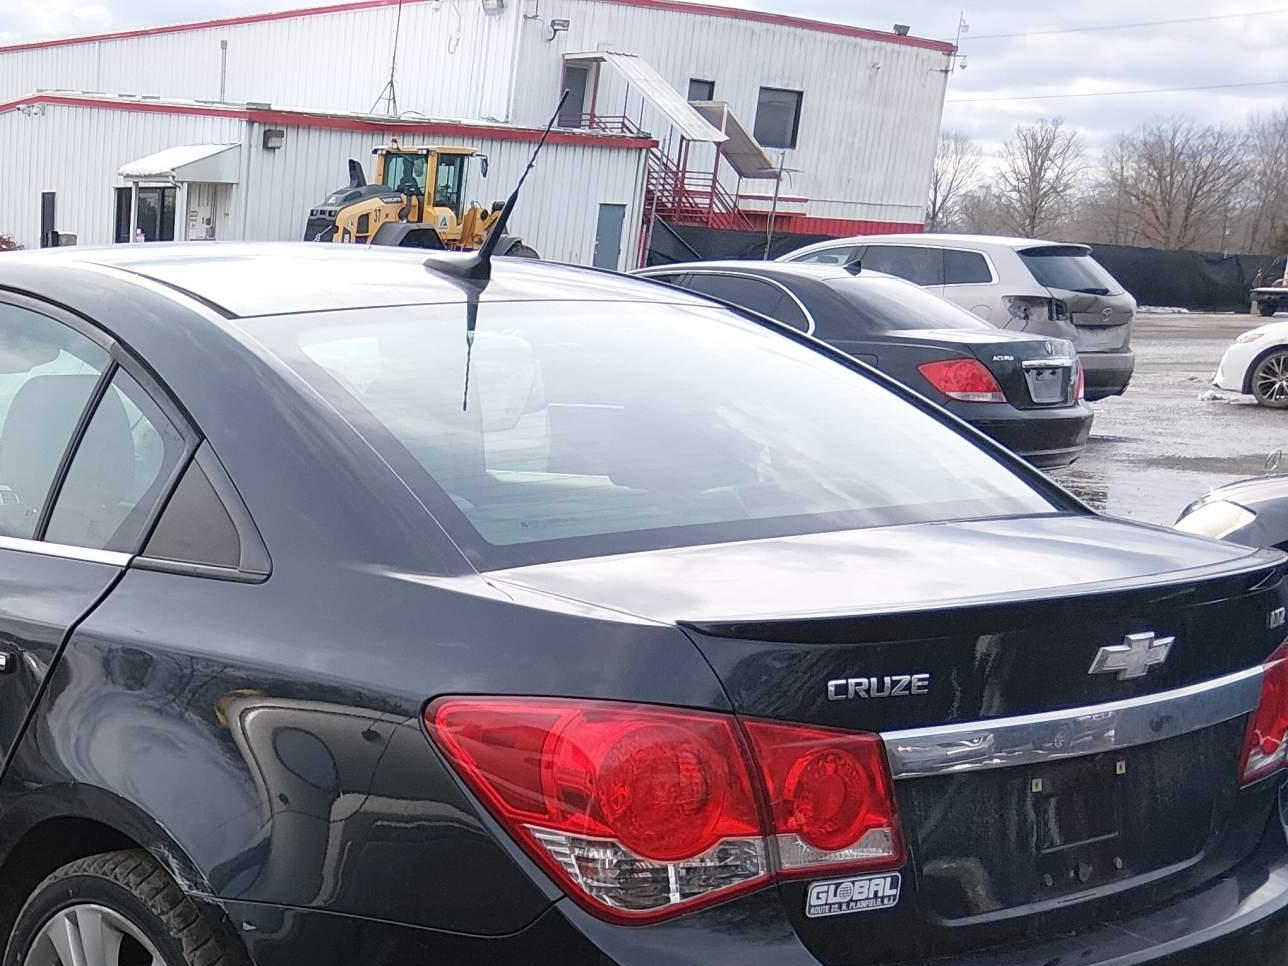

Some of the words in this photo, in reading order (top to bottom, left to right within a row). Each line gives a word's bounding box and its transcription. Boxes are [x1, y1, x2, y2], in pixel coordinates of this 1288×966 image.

[827, 673, 930, 701] CRUZE
[810, 877, 897, 906] GLOBAL
[810, 905, 830, 915] ROUTE
